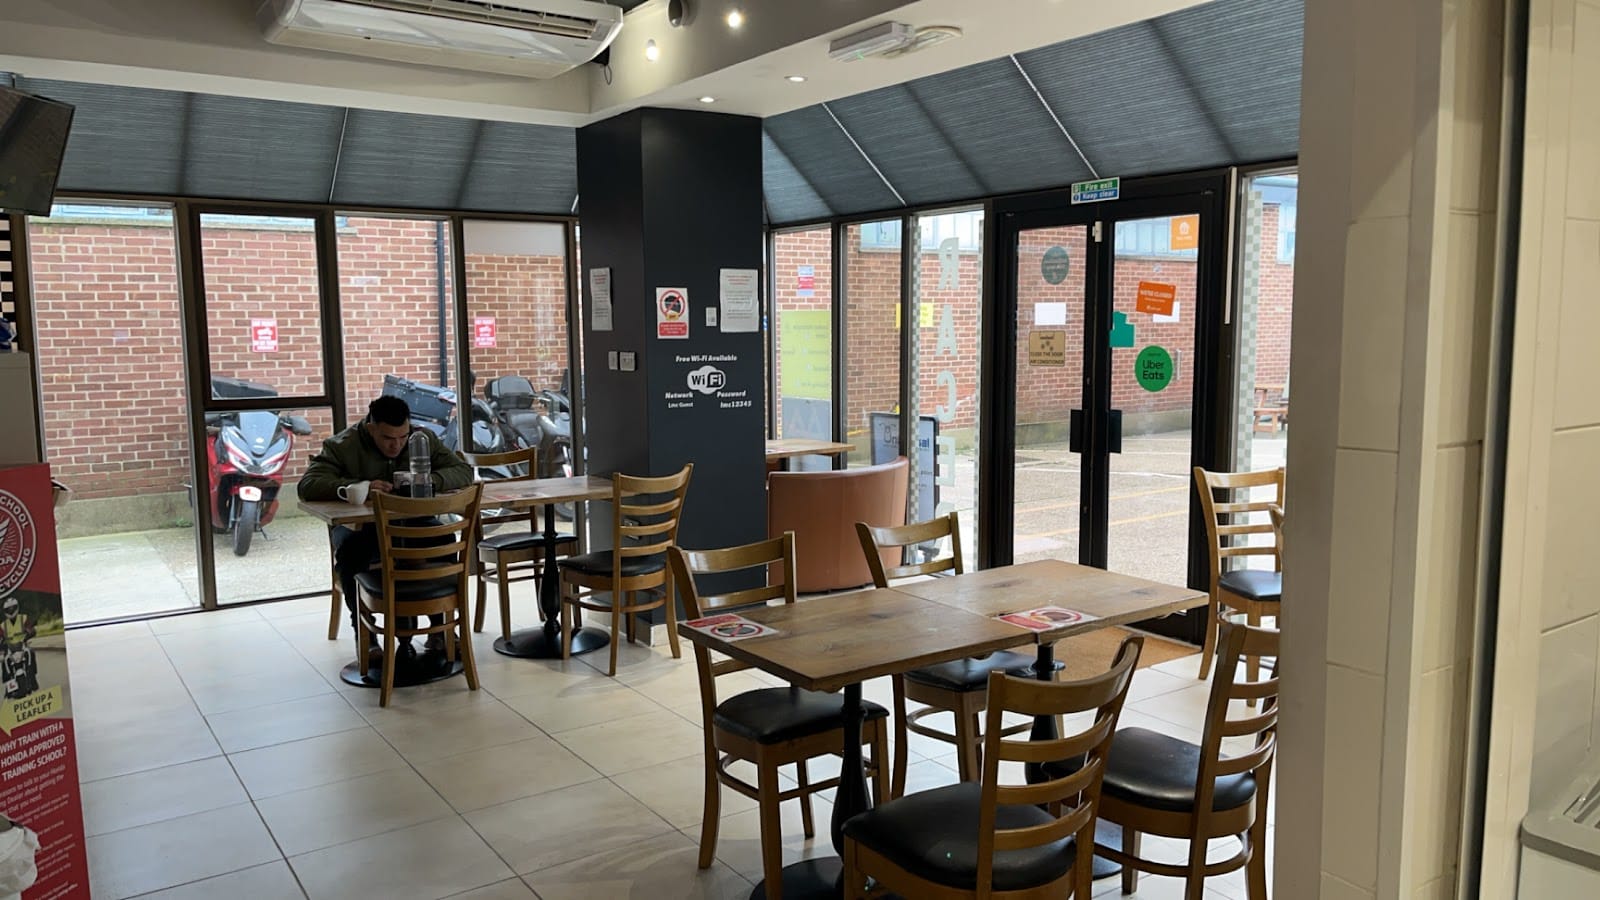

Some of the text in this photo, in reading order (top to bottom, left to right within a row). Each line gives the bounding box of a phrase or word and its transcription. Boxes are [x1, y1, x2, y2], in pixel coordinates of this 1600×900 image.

[1085, 180, 1113, 191] Fire exit
[1082, 190, 1115, 200] Keep clear
[708, 354, 738, 362] Available
[1142, 359, 1165, 370] Uber
[1142, 370, 1165, 380] Eats
[716, 389, 747, 398] Password
[13, 691, 54, 713] PICK UP A
[16, 702, 53, 723] LEAFLET
[0, 720, 64, 754] WHY TRAIN WITH A
[0, 733, 66, 768] HONDA APPROVED
[2, 745, 67, 781] TRAINING SCHOOL?
